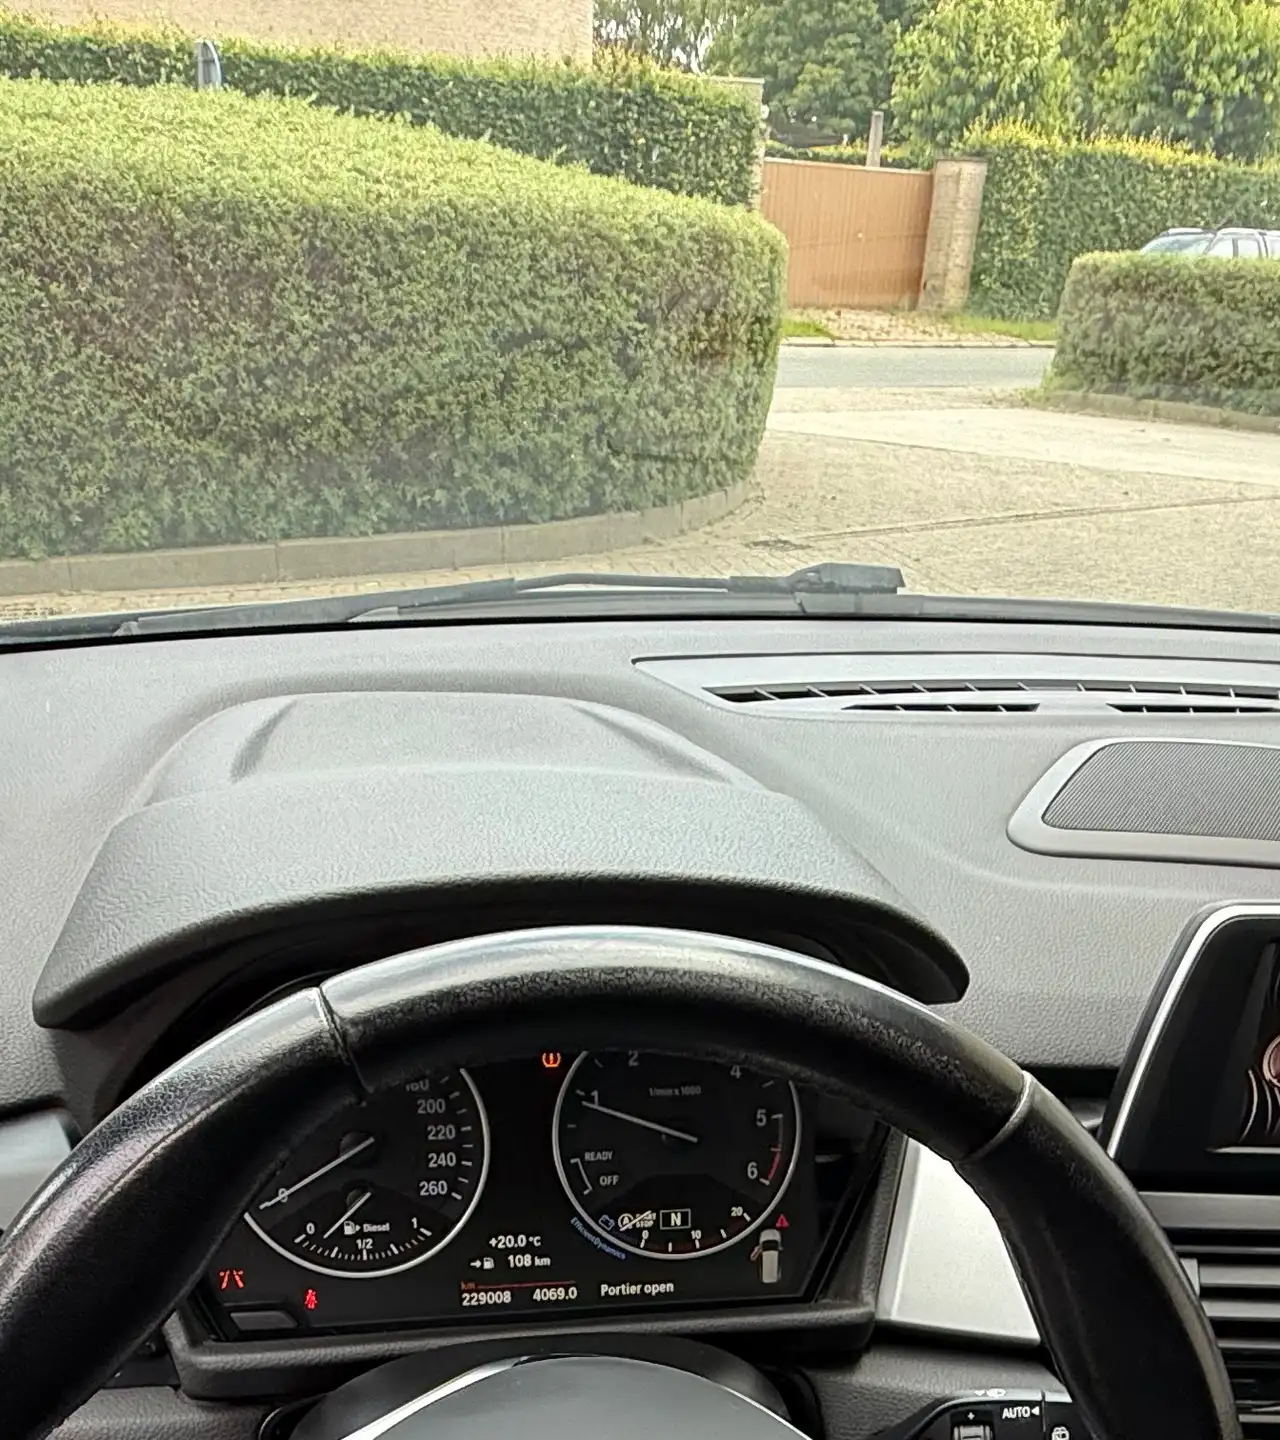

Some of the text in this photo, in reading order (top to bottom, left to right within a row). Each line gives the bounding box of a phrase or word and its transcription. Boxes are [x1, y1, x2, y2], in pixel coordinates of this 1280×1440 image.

[628, 1050, 639, 1067] 2
[730, 1065, 742, 1079] 4
[590, 1090, 599, 1106] 1
[417, 1099, 446, 1114] 200
[756, 1109, 767, 1127] 5
[427, 1125, 456, 1141] 220
[428, 1152, 457, 1168] 240
[584, 1151, 613, 1161] READY
[747, 1162, 758, 1179] 6
[599, 1175, 619, 1186] OFF
[419, 1180, 448, 1196] 260
[671, 1212, 682, 1226] N
[730, 1207, 743, 1217] 20
[306, 1223, 315, 1235] 0
[362, 1222, 390, 1233] Diesel
[411, 1217, 418, 1229] 1
[489, 1234, 527, 1249] +20.0
[642, 1230, 649, 1240] 0
[691, 1230, 702, 1240] 10
[356, 1238, 373, 1250] 1/2
[508, 1254, 551, 1268] 108 km
[460, 1280, 475, 1290] km
[600, 1281, 675, 1297] Portier open
[461, 1287, 578, 1307] 229008 4069.0
[1002, 1406, 1031, 1420] AUTO
